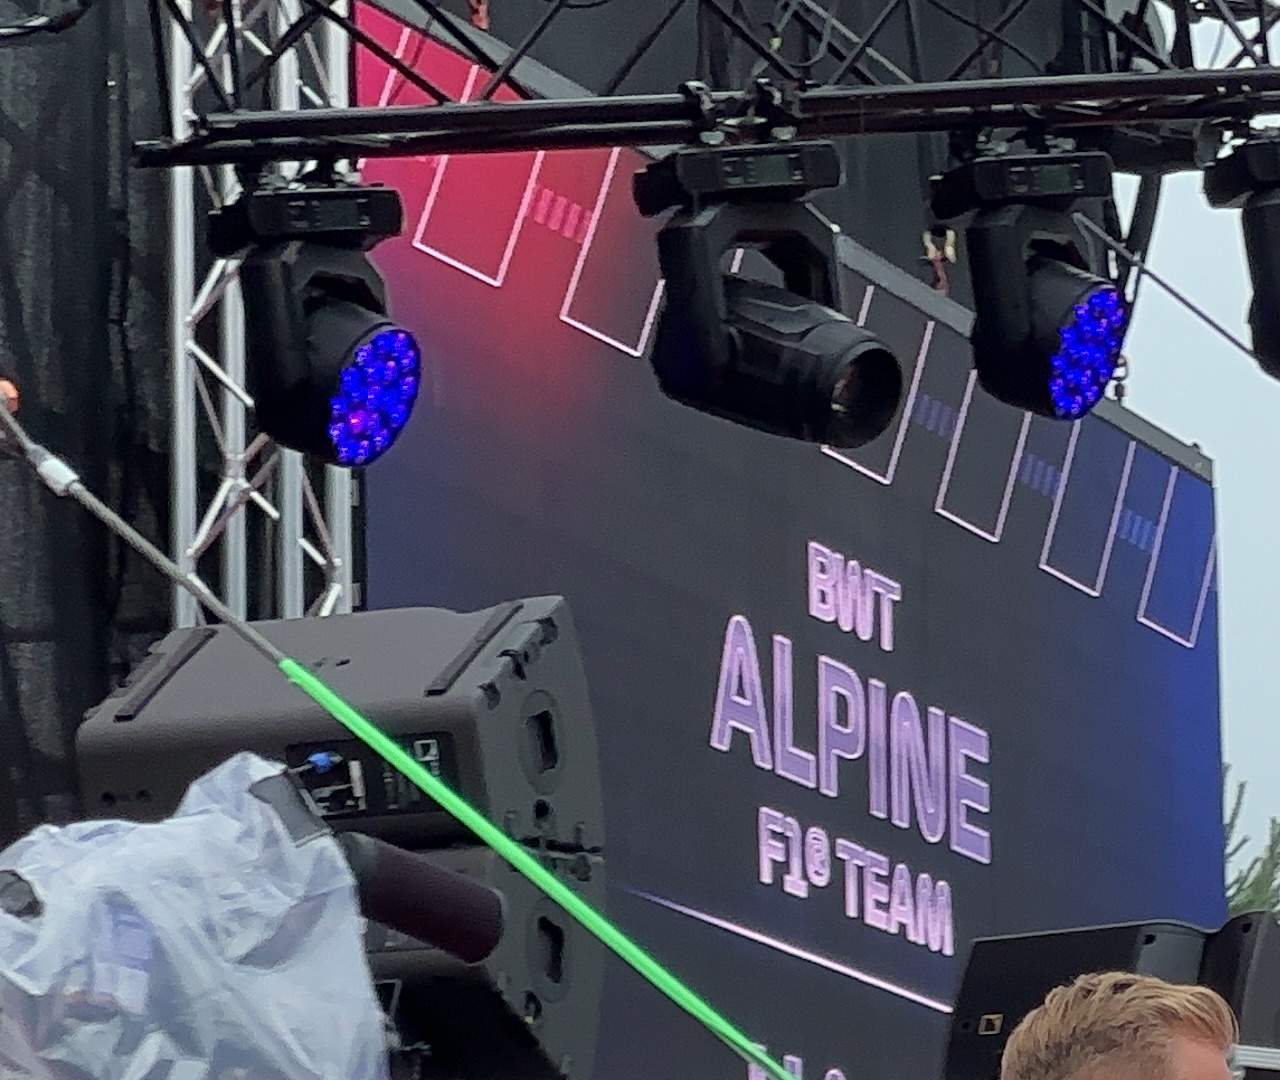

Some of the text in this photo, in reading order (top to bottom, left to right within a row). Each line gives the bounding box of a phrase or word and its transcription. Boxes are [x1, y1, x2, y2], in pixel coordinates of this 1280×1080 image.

[807, 540, 901, 652] BWT
[710, 614, 992, 865] ALPINE
[835, 836, 955, 957] TEAM
